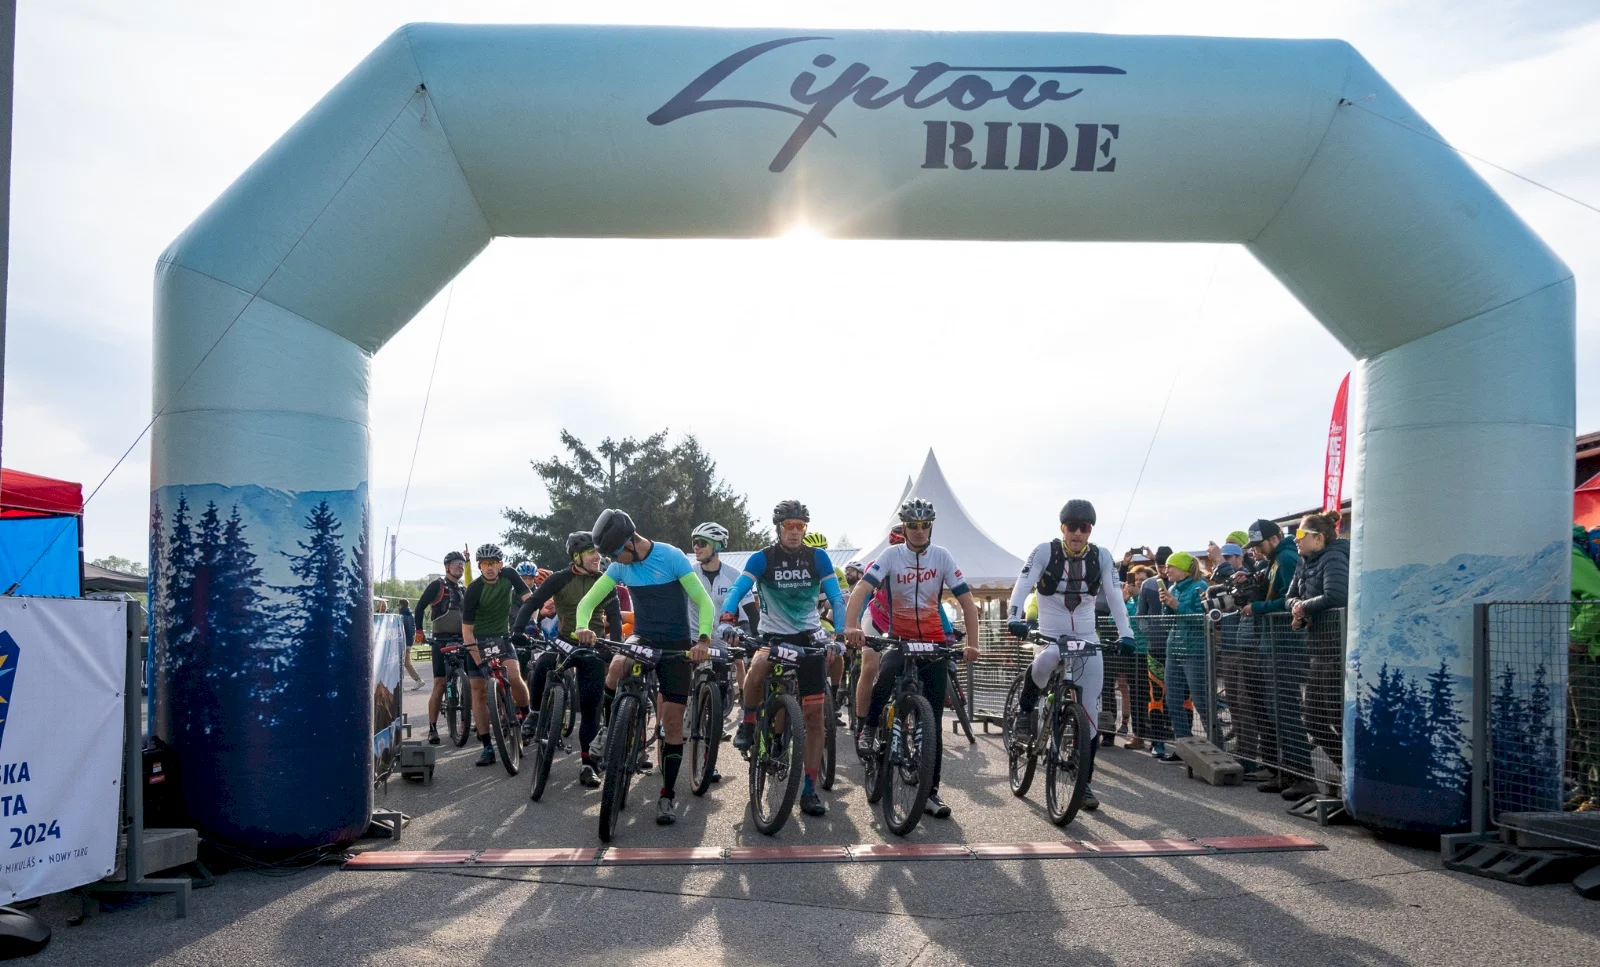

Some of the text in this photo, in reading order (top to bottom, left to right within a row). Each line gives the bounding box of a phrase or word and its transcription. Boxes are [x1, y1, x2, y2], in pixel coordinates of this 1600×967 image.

[647, 36, 1127, 173] Liptov
[921, 120, 1120, 173] RIDE
[774, 568, 811, 581] BORA
[777, 579, 811, 589] hansgrohe
[630, 645, 653, 658] 114
[907, 642, 934, 652] 108
[1066, 640, 1086, 651] 97
[777, 646, 798, 662] 112
[0, 762, 31, 785] KA
[9, 819, 61, 849] 2024
[5, 856, 37, 874] MIKULÁŠ
[48, 850, 72, 864] NOWY
[74, 846, 89, 858] TARG
